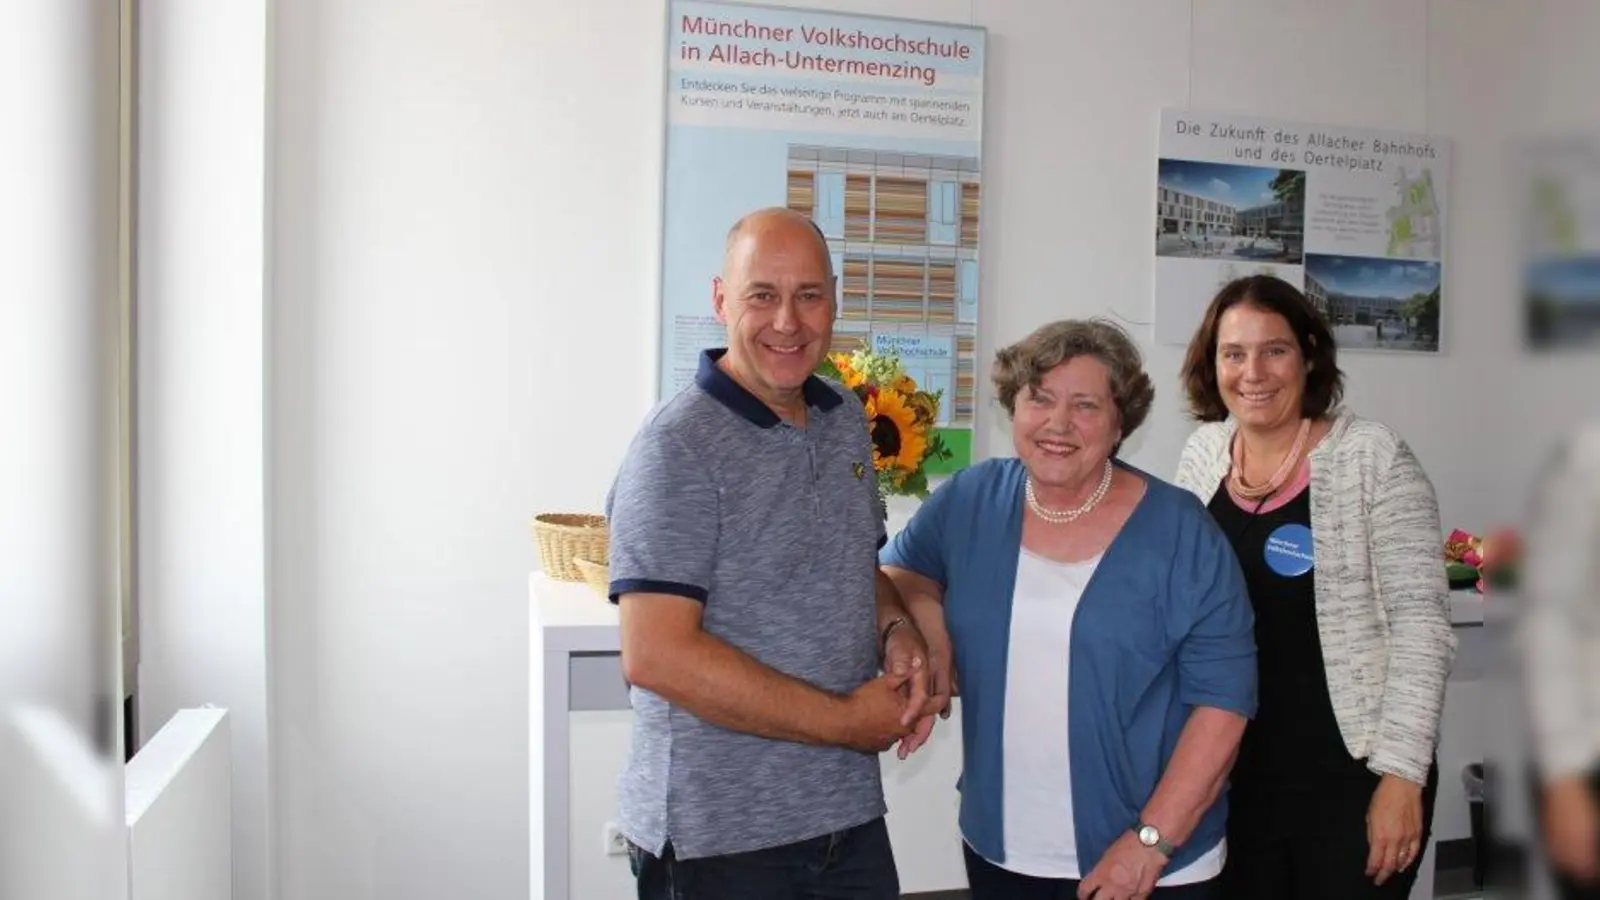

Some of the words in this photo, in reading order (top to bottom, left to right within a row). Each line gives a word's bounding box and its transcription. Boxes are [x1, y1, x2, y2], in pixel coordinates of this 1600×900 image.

[682, 15, 793, 42] Münchner
[800, 25, 971, 59] Volkshochschule
[681, 41, 700, 60] in
[708, 43, 937, 85] Allach-Untermenzing
[681, 78, 738, 93] Entdecken
[741, 82, 757, 95] Sie
[759, 84, 778, 95] das
[834, 89, 886, 104] Programm
[888, 96, 907, 106] mit
[909, 97, 970, 112] spannenden
[681, 95, 718, 107] Kursen
[722, 98, 743, 109] und
[863, 108, 888, 120] auch
[891, 111, 908, 121] am
[1176, 120, 1202, 135] Die
[1209, 123, 1265, 143] Zukunft
[1274, 129, 1299, 146] des
[1307, 133, 1365, 152] Allacher
[1373, 139, 1436, 160] Bahnhofs
[1234, 146, 1262, 161] und
[1271, 148, 1296, 163] des
[1304, 150, 1384, 172] Oertelplatz
